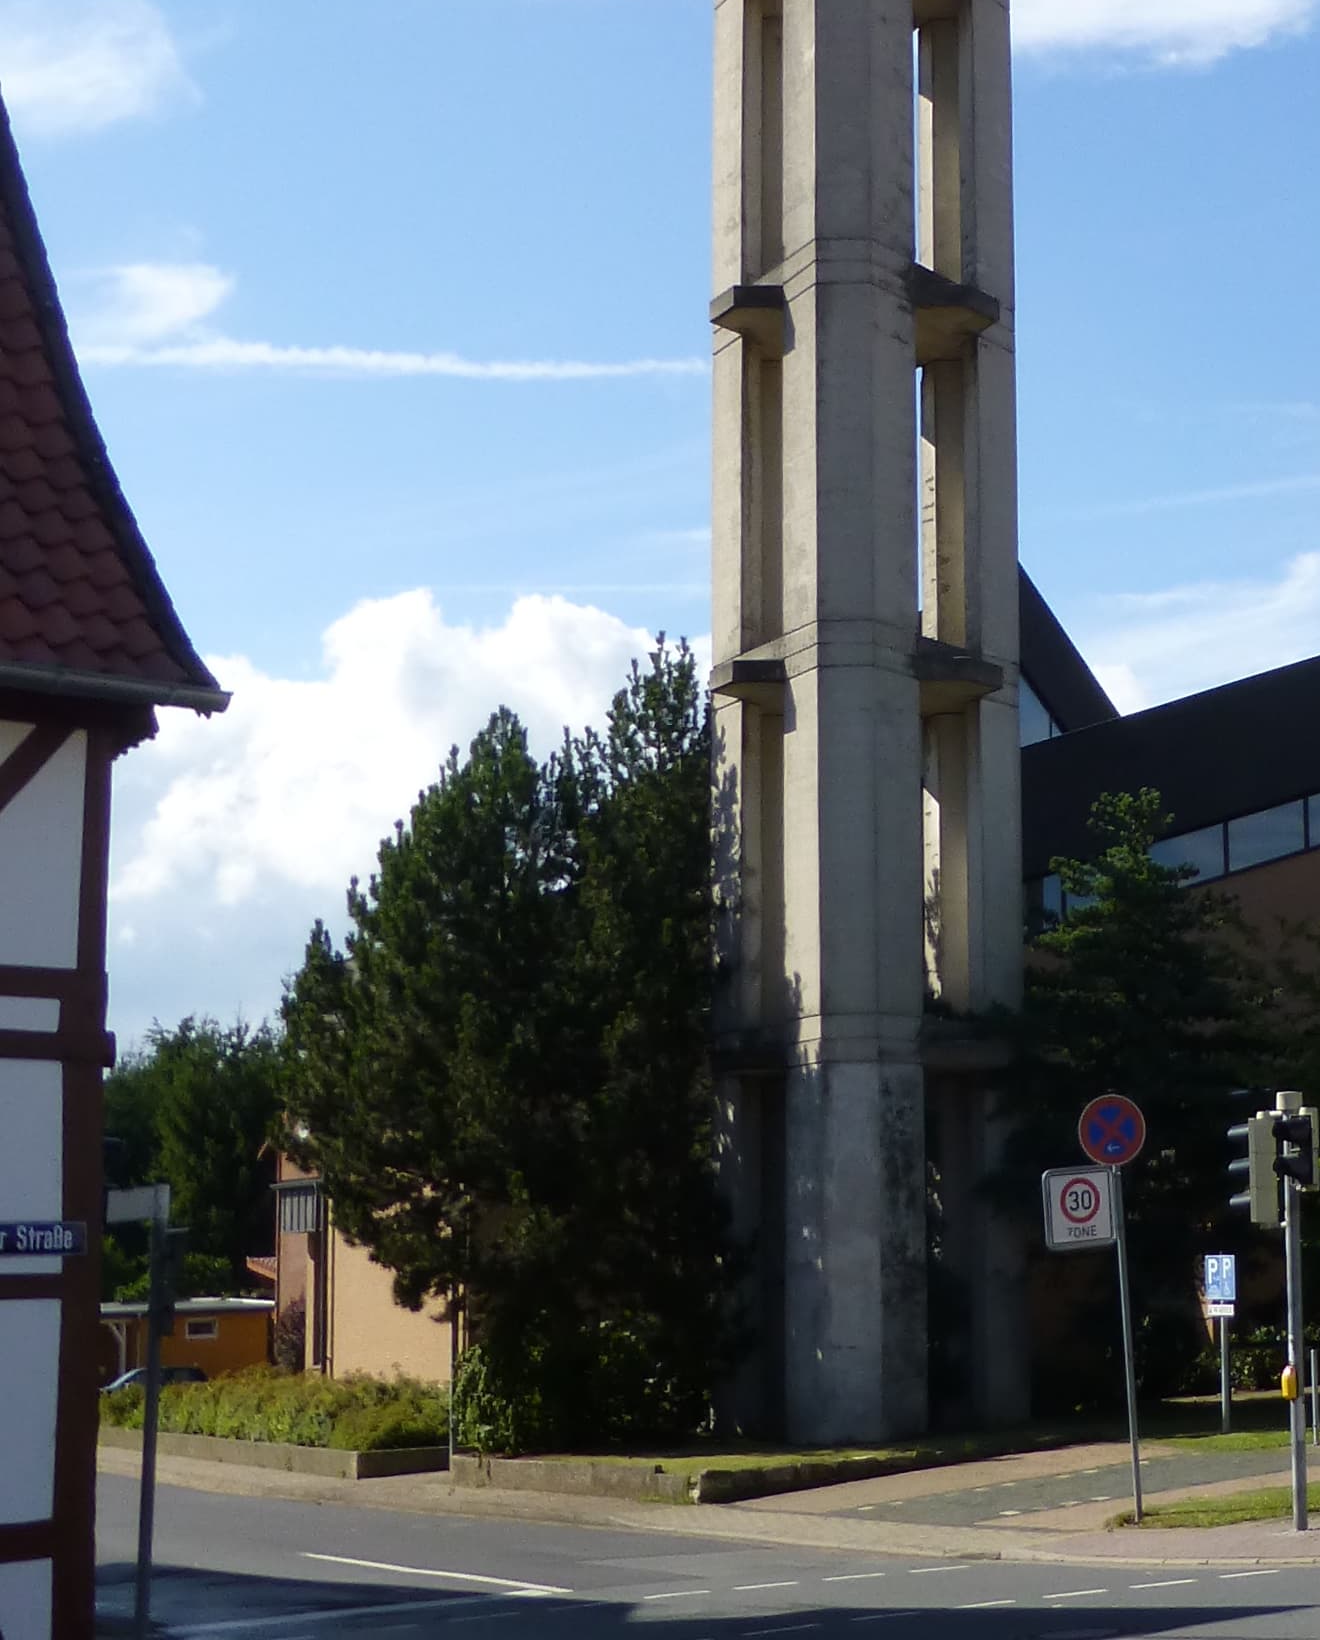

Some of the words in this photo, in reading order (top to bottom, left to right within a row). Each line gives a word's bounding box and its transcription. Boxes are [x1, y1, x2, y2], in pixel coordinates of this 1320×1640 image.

[1068, 1190, 1092, 1211] 30
[16, 1224, 73, 1250] Straße
[1067, 1224, 1097, 1238] ZONE
[1207, 1258, 1218, 1284] P
[1222, 1257, 1231, 1279] P
